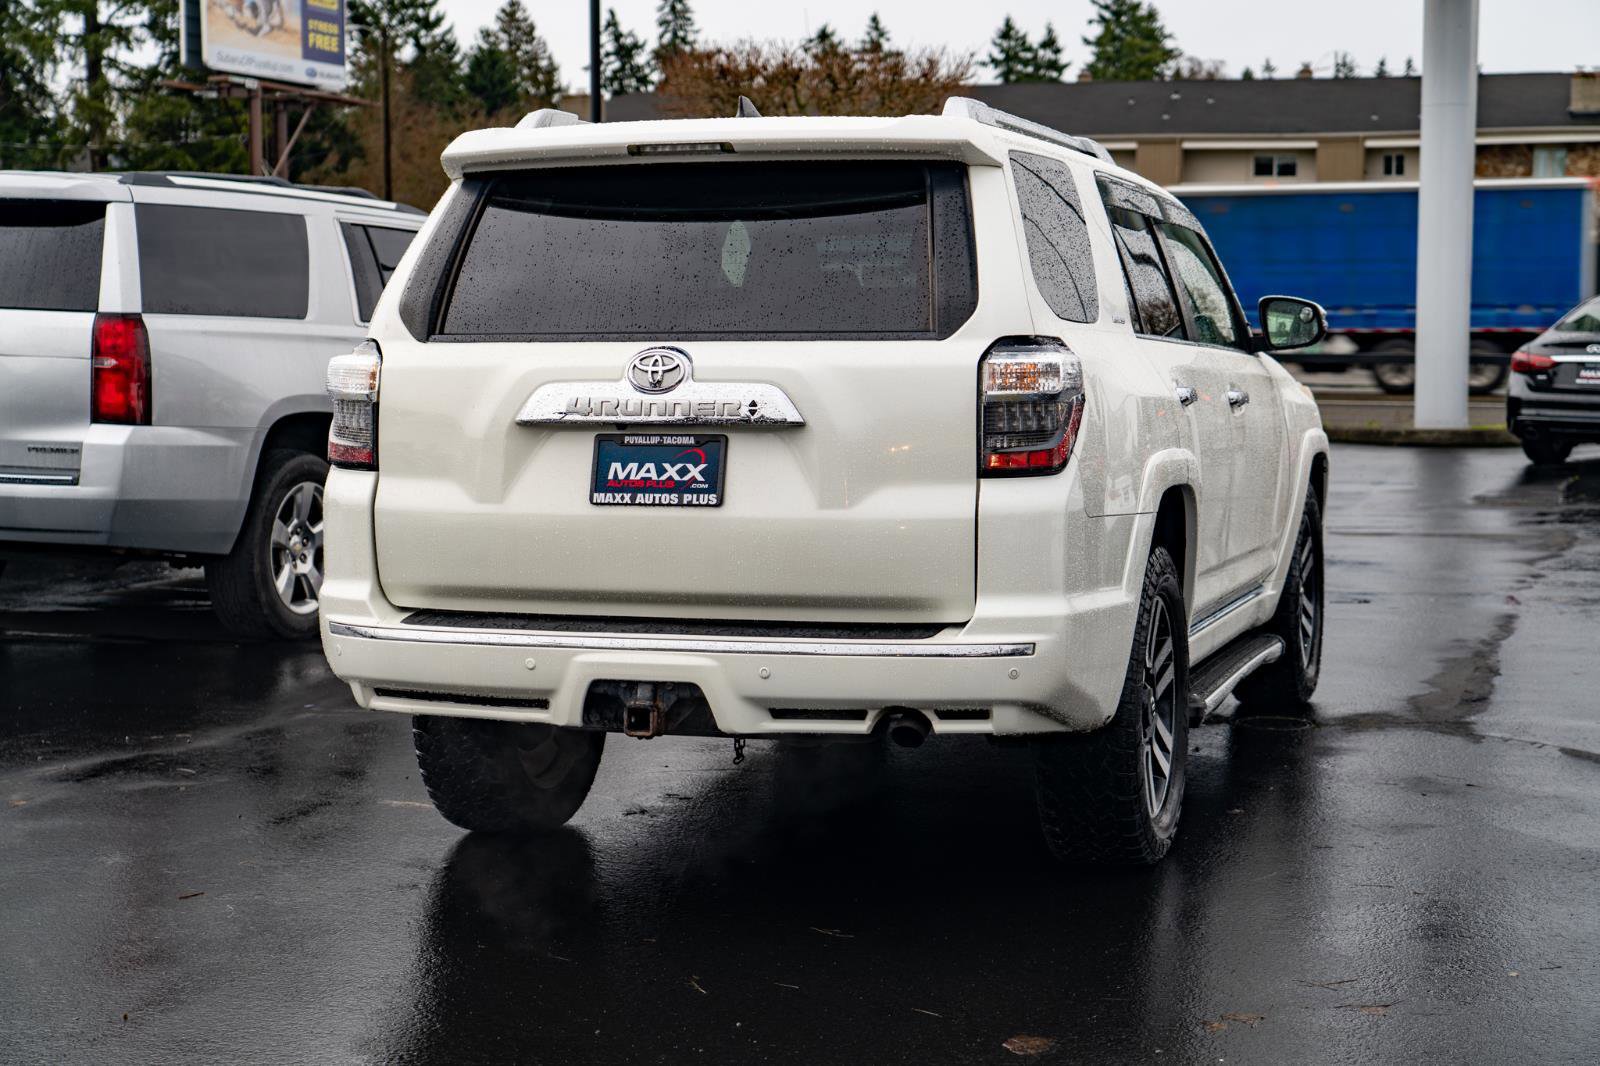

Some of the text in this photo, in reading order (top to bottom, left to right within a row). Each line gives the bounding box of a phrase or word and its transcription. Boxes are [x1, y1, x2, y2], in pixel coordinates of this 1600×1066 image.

[308, 33, 339, 52] FREE
[565, 397, 741, 417] 4RUNNER
[607, 462, 708, 481] MAXX
[607, 480, 676, 489] AUTOS PLUS
[593, 493, 718, 505] MAXX AUTOS PLUS
